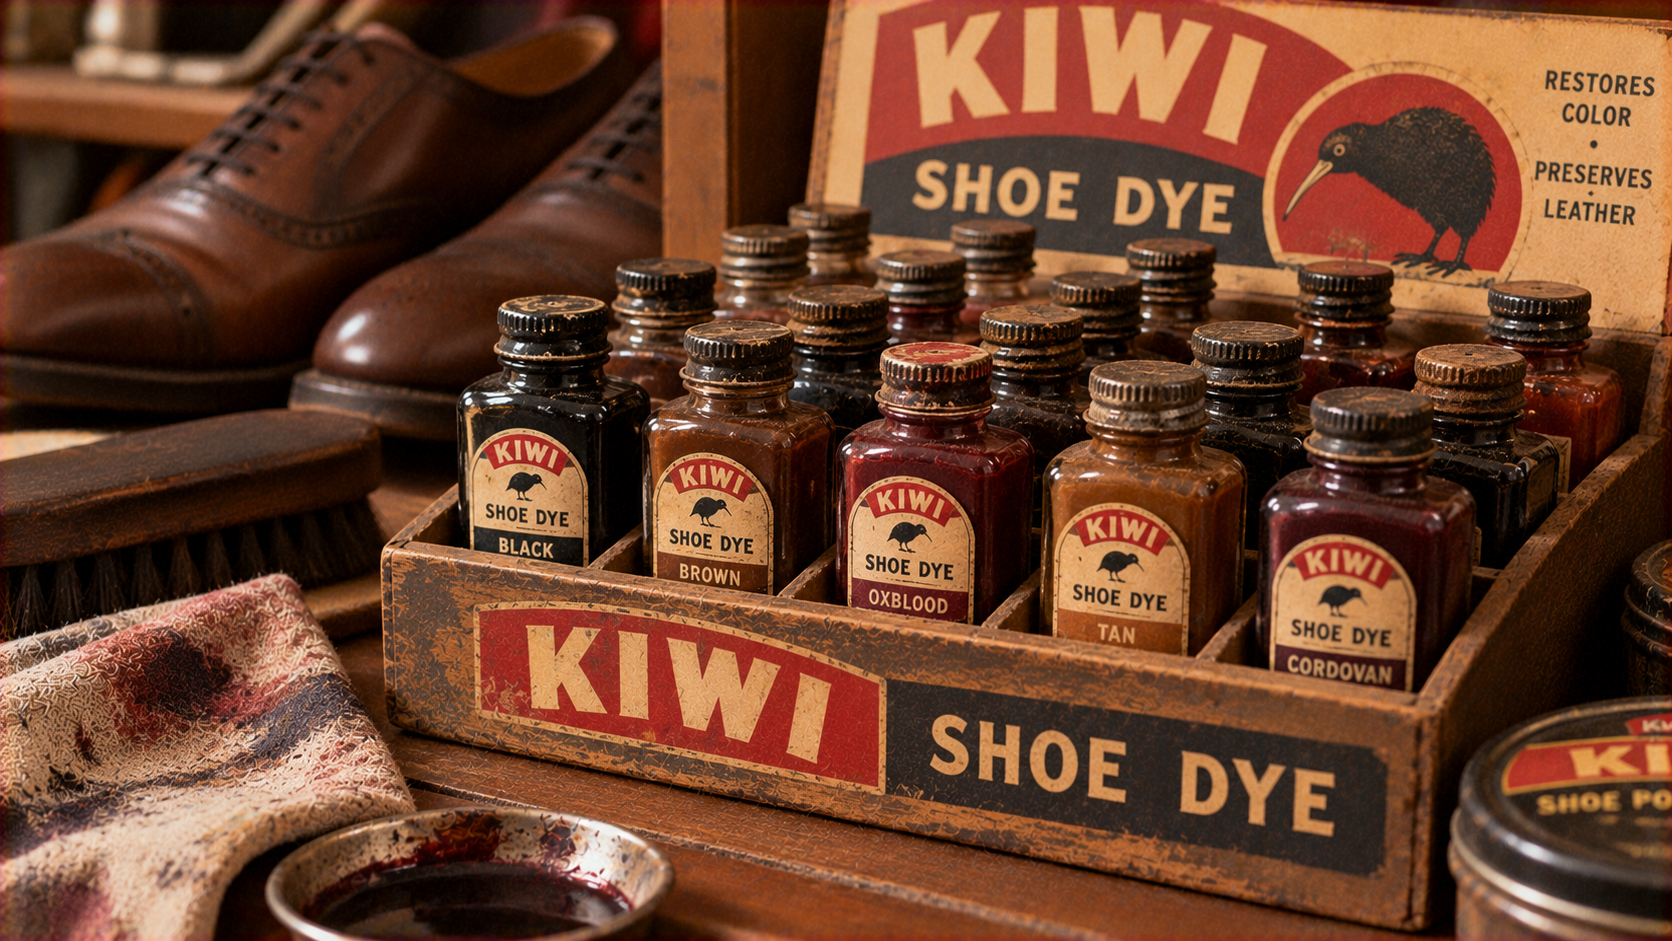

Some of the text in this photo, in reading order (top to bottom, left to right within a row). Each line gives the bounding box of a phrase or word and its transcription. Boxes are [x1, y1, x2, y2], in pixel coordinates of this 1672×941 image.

[912, 5, 1268, 146] KIWI
[1544, 69, 1656, 98] RESTORES
[1561, 102, 1632, 127] COLOR
[1534, 160, 1653, 190] PRESERVES
[913, 159, 1236, 234] SHOE DYE
[1544, 197, 1636, 226] LEATHER
[494, 440, 560, 469] KIWI
[678, 464, 744, 495] KIWI
[485, 503, 569, 527] SHOE DYE
[876, 488, 946, 519] KIWI
[669, 528, 754, 555] SHOE DYE
[1084, 515, 1160, 547] KIWI
[498, 536, 554, 559] BLACK
[679, 562, 741, 587] BROWN
[865, 553, 954, 581] SHOE DYE
[1304, 548, 1385, 582] KIWI
[868, 588, 949, 614] OXBLOOD
[1072, 583, 1168, 612] SHOE DYE
[1097, 622, 1136, 645] TAN
[1291, 618, 1392, 648] SHOE DYE
[1287, 655, 1392, 684] CORDOVAN
[526, 624, 832, 764] KIWI
[930, 714, 1337, 838] SHOE DYE
[1536, 790, 1622, 816] SHOE
